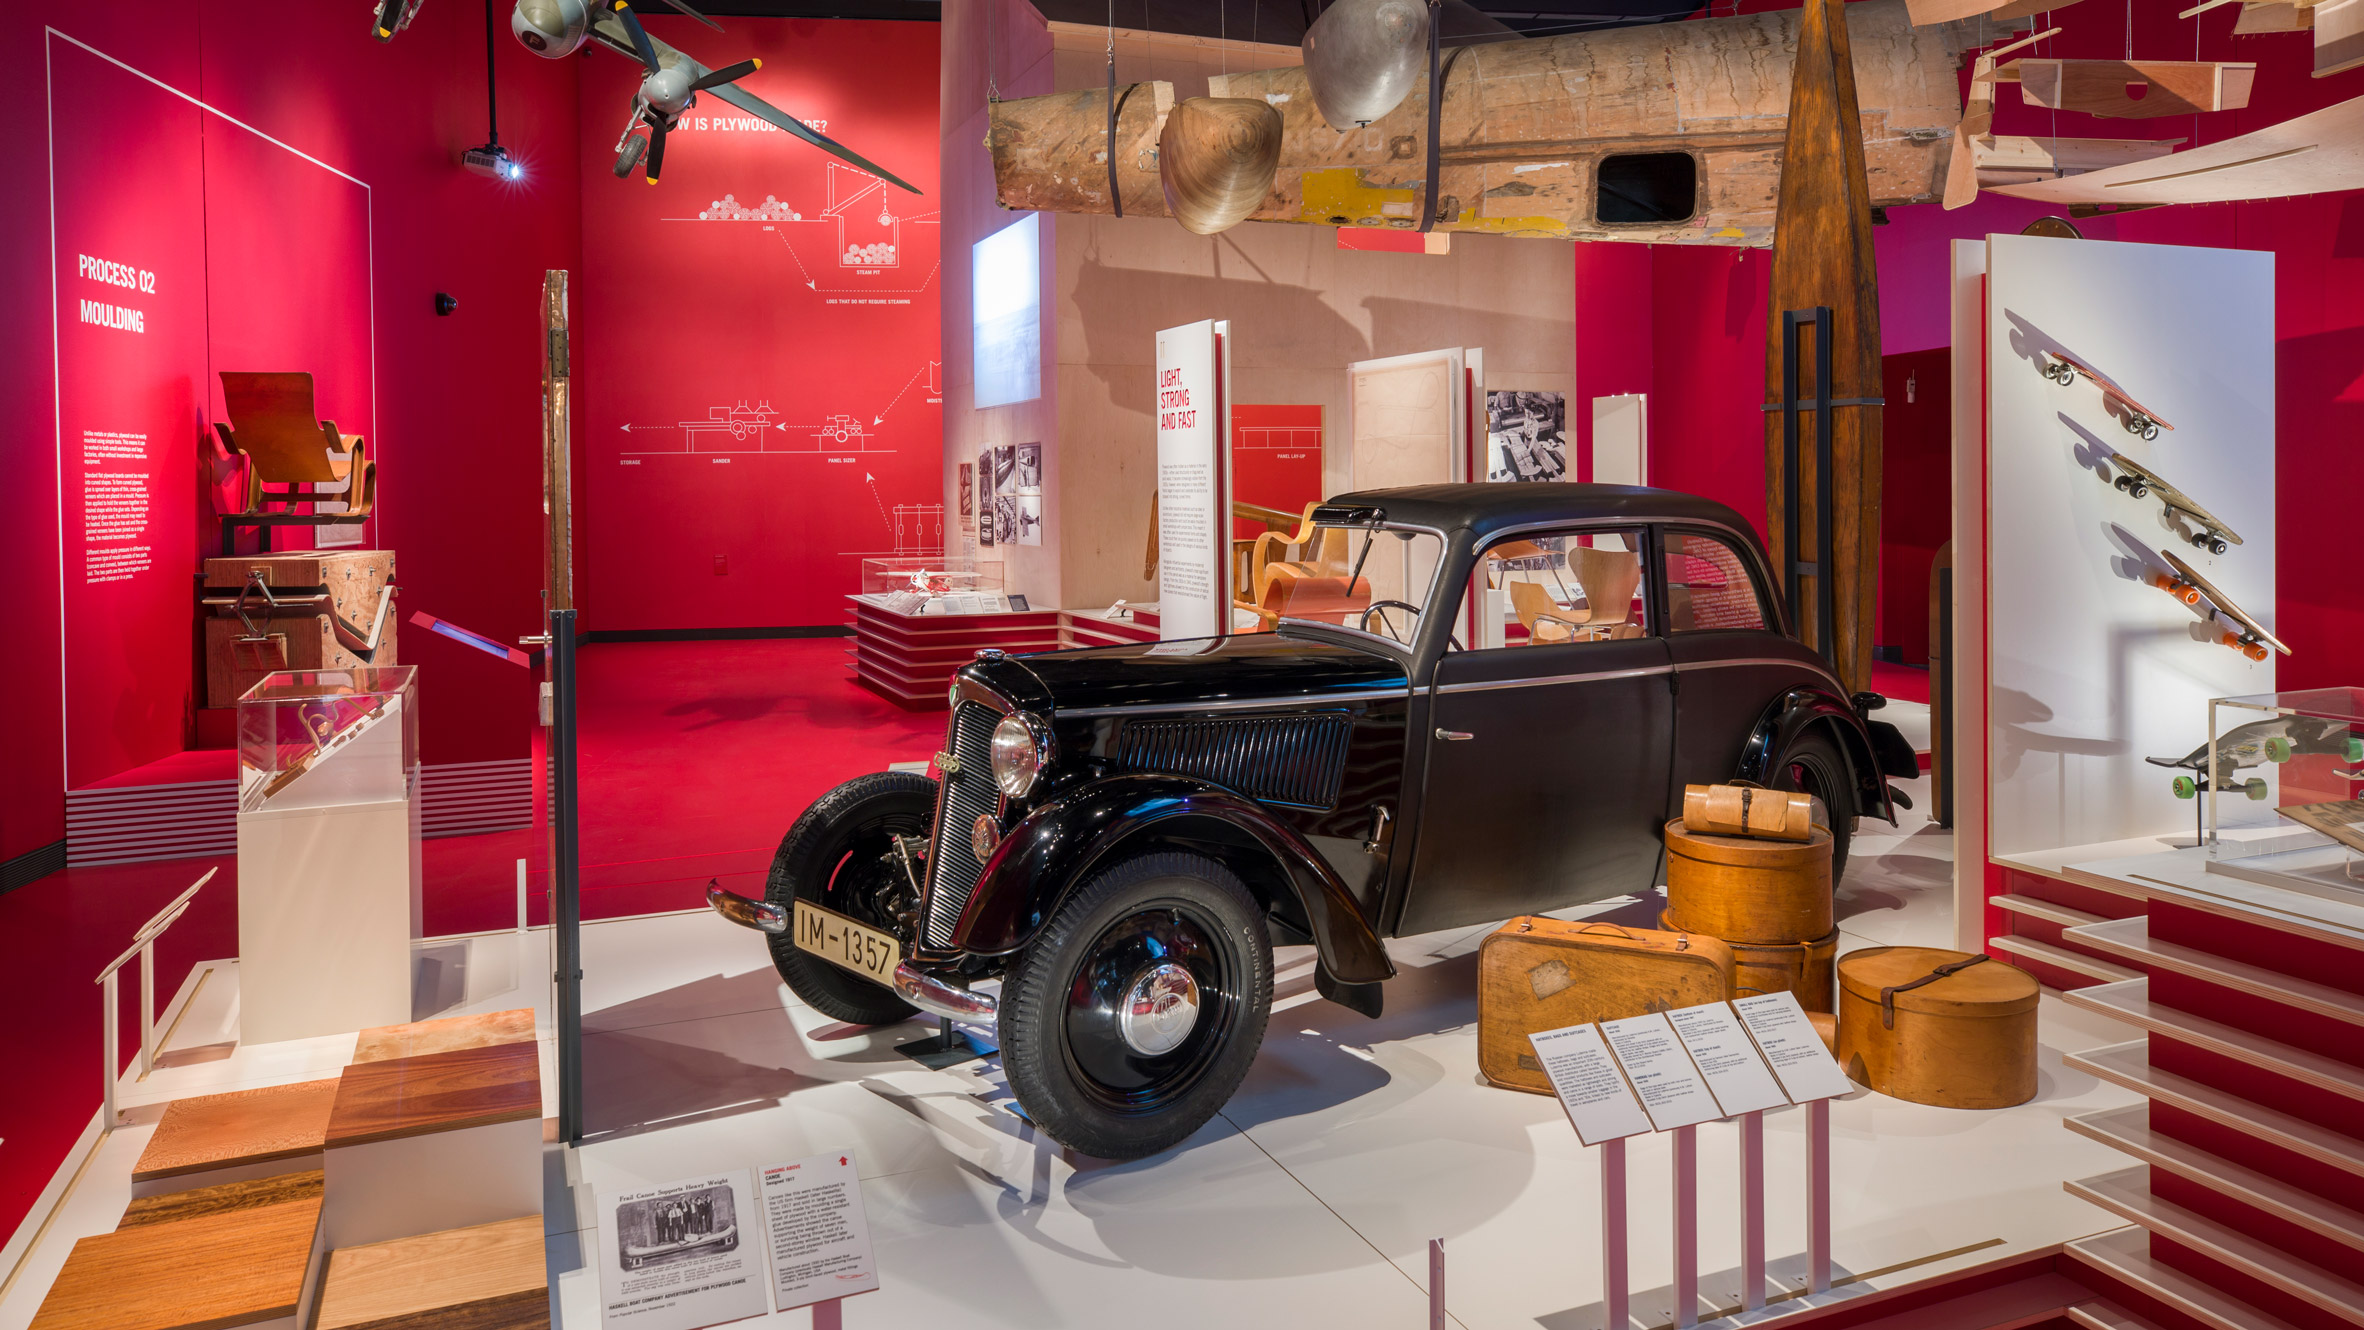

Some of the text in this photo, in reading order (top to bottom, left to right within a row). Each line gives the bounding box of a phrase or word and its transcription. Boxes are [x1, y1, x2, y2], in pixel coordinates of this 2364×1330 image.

[695, 117, 708, 131] IS
[713, 117, 777, 132] PLYWOOD
[79, 253, 156, 295] PROCESS 02
[81, 298, 144, 334] MOULDING
[1160, 367, 1183, 389] LIGHT,
[1161, 388, 1190, 410] STRONG
[1161, 410, 1197, 431] AND FAST
[801, 909, 891, 975] IM-1357
[1243, 926, 1262, 1013] CONTINENTAL
[619, 1178, 728, 1202] Frail Canoe Supports Heavy Weight
[766, 1178, 784, 1186] Designed
[608, 1301, 628, 1310] HASKELL
[641, 1294, 663, 1303] COMPANY
[664, 1287, 700, 1298] ADVERTISEMENT
[710, 1281, 731, 1289] PLYWOOD
